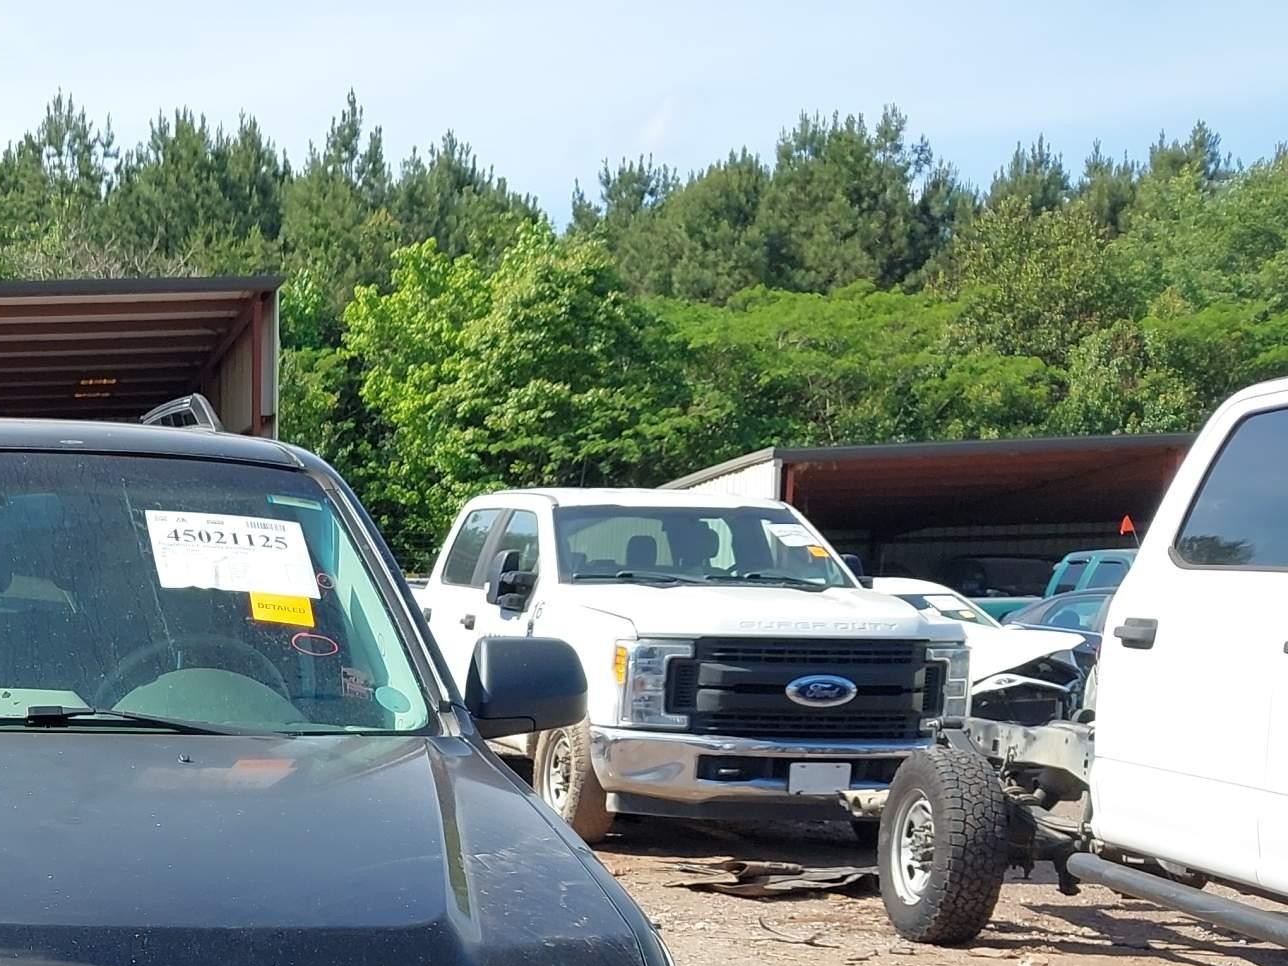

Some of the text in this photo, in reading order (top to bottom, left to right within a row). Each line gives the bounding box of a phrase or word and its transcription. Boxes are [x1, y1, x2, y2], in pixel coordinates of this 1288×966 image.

[166, 528, 289, 551] 45021125
[257, 601, 306, 615] DETAILED
[738, 620, 898, 631] SUPER DUTY
[805, 682, 841, 699] Ford
